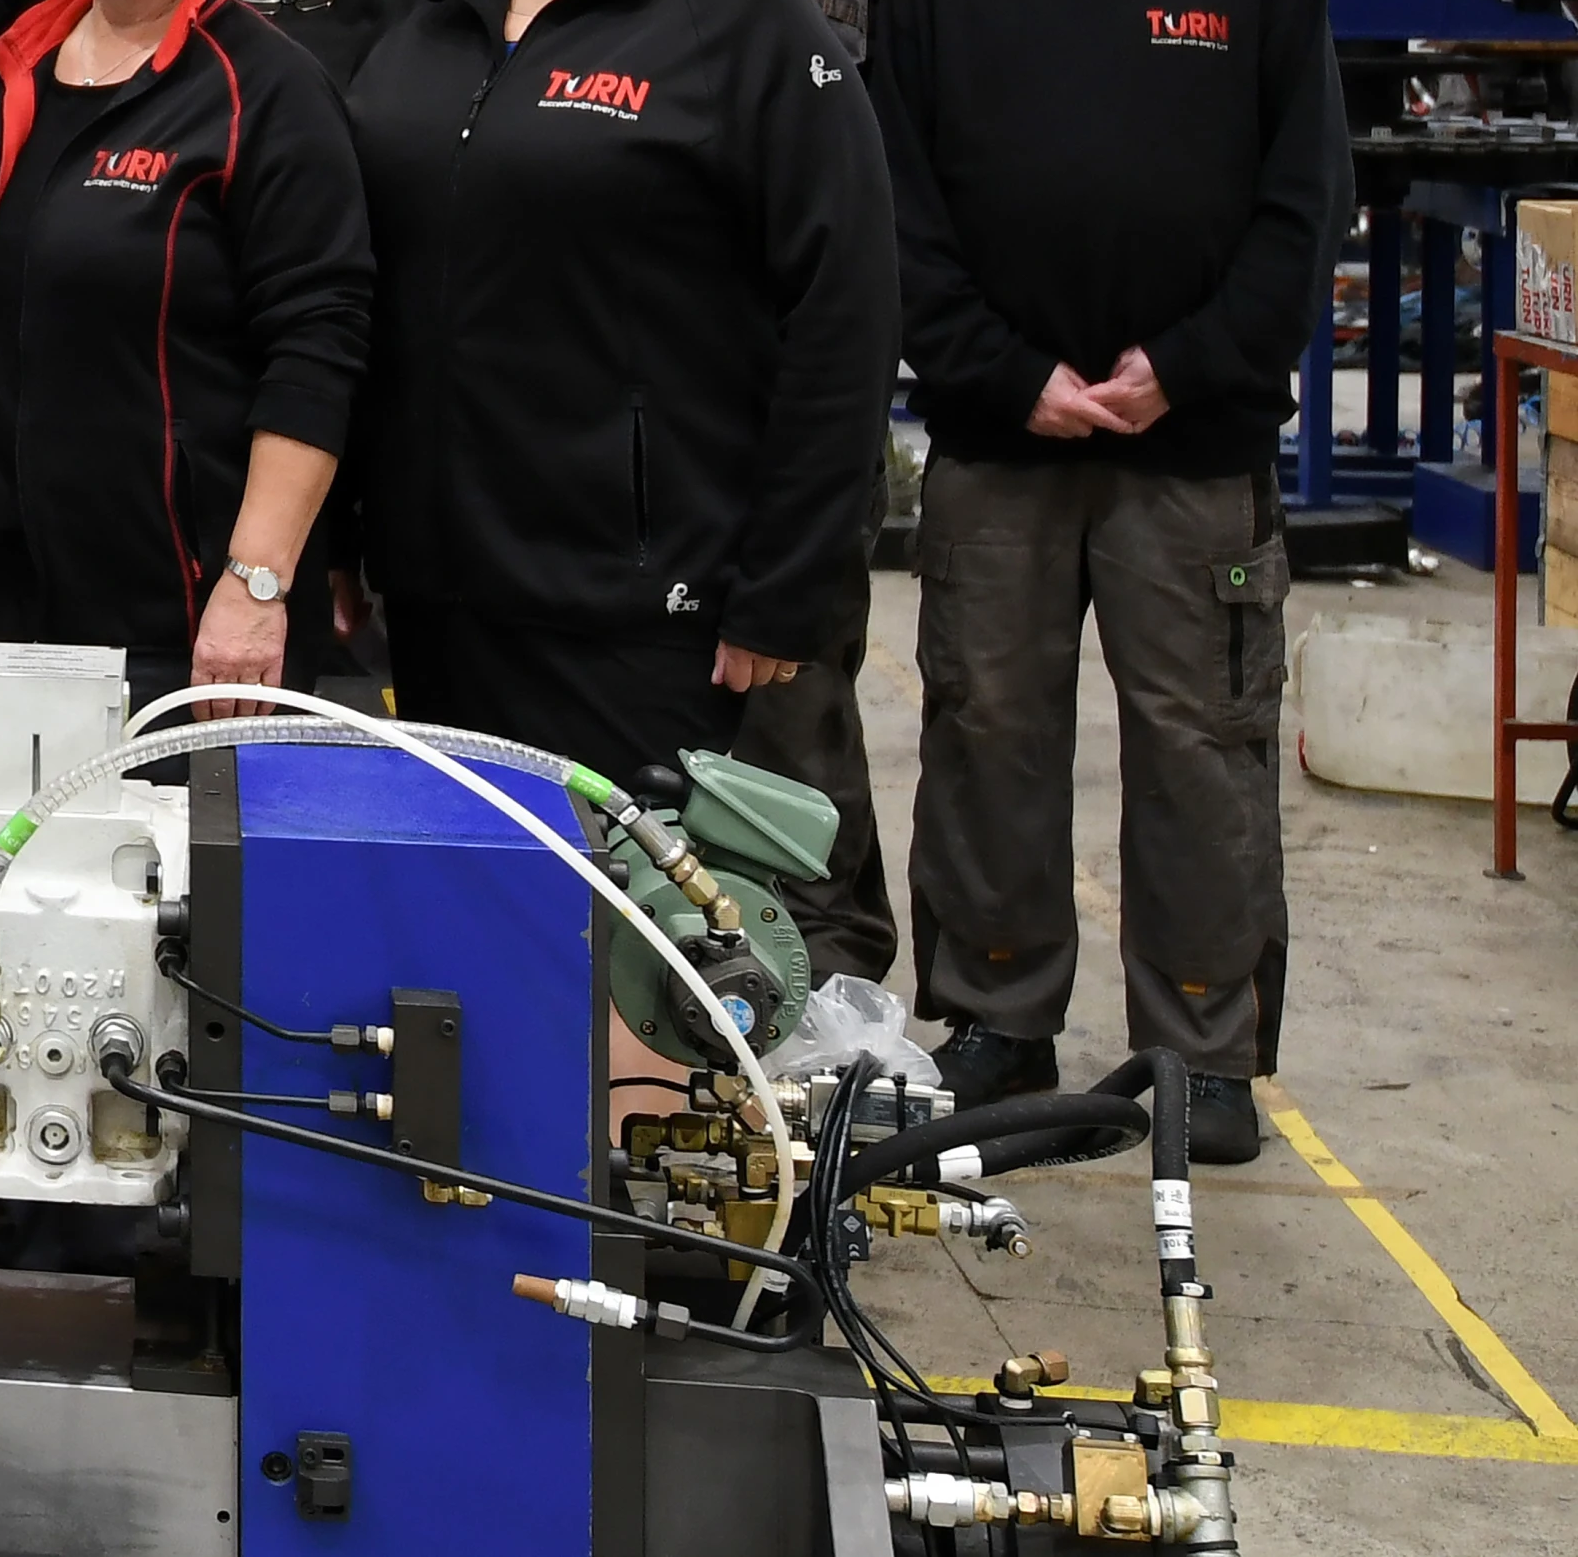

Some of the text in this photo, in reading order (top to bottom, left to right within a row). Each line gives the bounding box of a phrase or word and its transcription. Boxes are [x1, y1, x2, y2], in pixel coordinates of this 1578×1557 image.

[1146, 9, 1229, 41] TURN
[545, 70, 650, 112] TURN
[592, 104, 618, 117] every
[618, 110, 638, 121] turn
[90, 149, 179, 182] TURN
